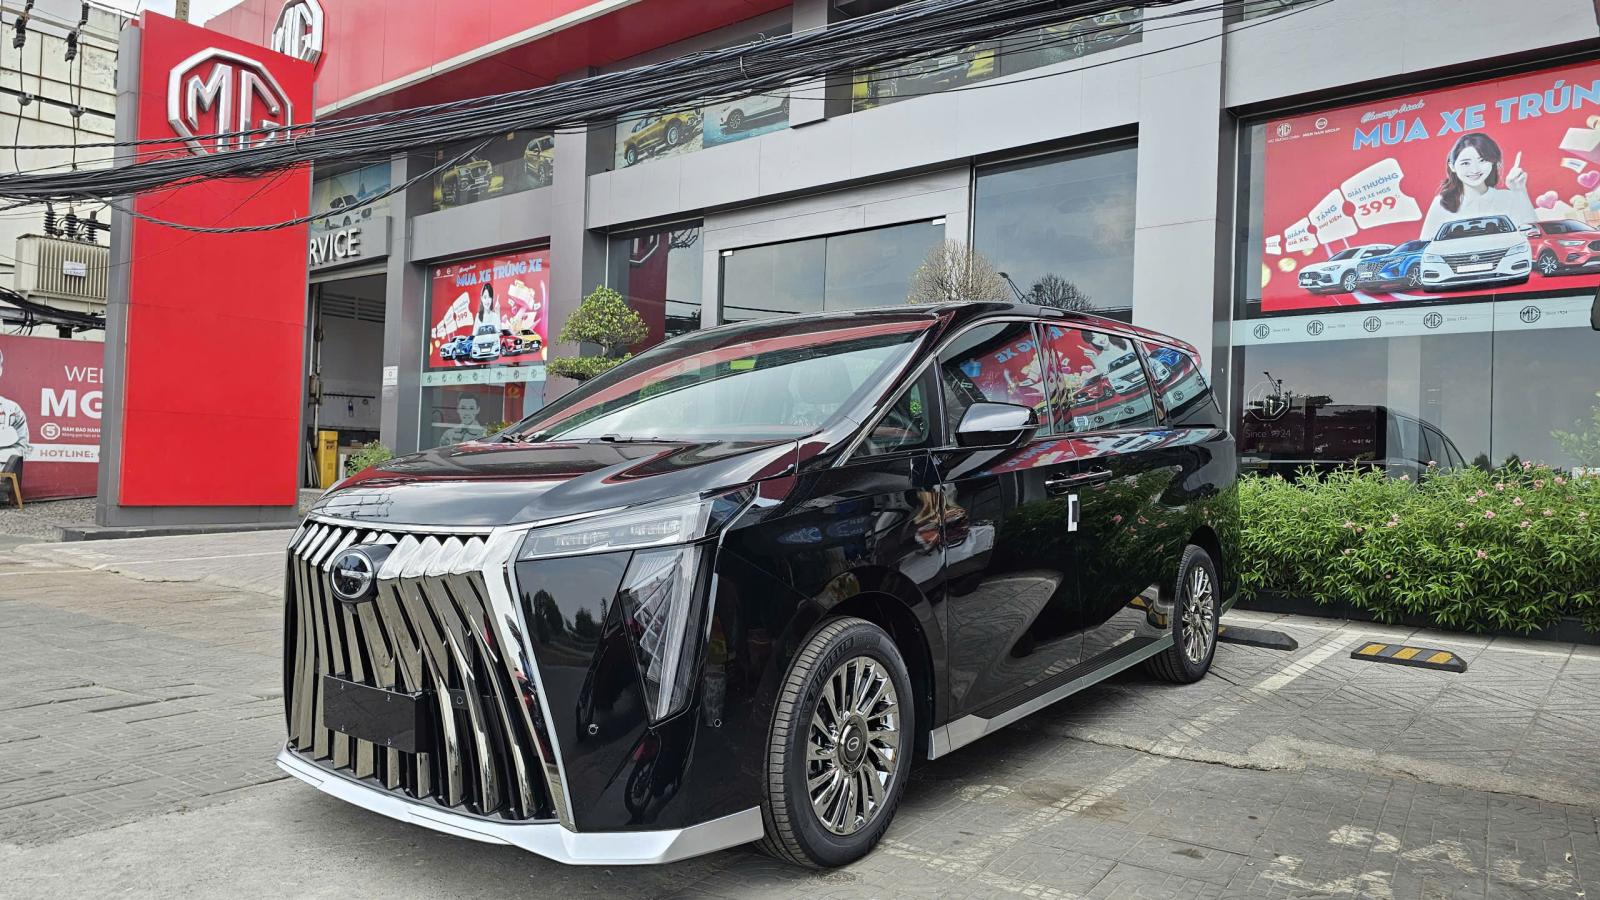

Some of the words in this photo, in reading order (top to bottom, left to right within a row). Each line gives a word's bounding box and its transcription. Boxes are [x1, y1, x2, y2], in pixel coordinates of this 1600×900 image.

[184, 60, 283, 152] MG
[1353, 116, 1430, 151] MUA
[1437, 104, 1486, 137] XE
[1358, 196, 1397, 216] 399
[309, 227, 359, 265] RVICE
[456, 273, 477, 288] MUA
[478, 267, 491, 284] XE
[528, 258, 542, 273] XE
[41, 387, 103, 419] MG
[40, 449, 94, 458] HOTLINE:
